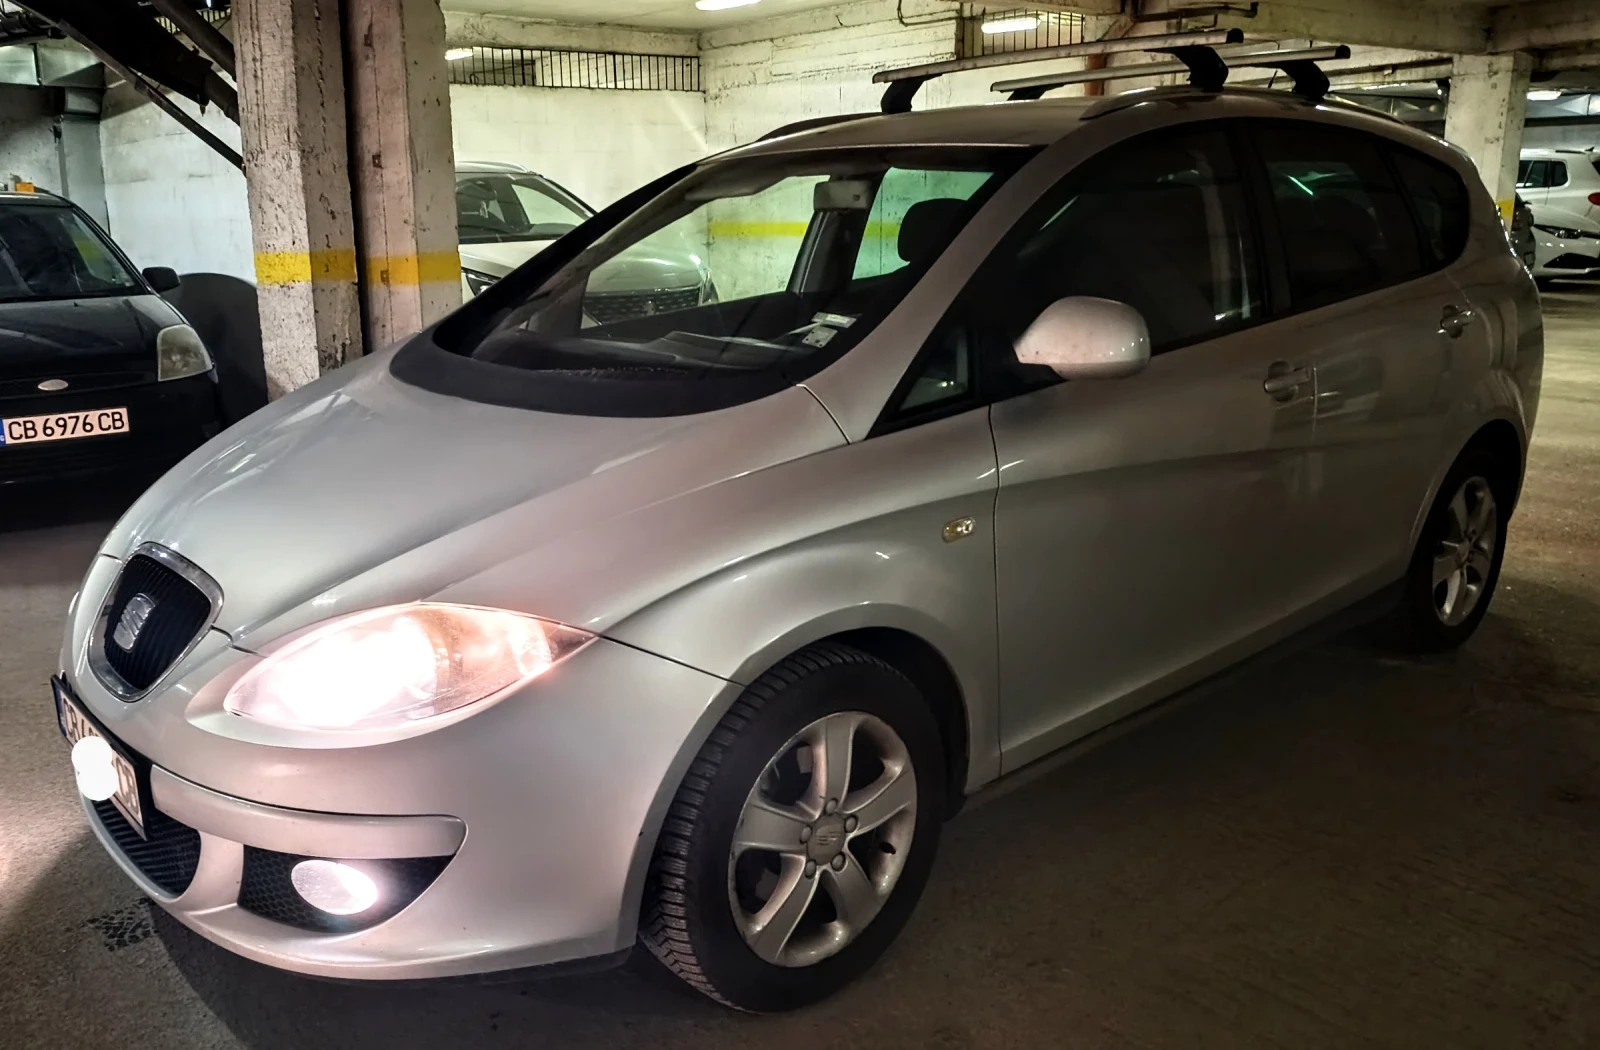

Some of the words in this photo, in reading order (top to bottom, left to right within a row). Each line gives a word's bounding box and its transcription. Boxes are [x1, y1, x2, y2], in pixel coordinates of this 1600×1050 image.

[8, 420, 38, 440] CB
[42, 414, 94, 437] 6976
[97, 411, 125, 432] CB
